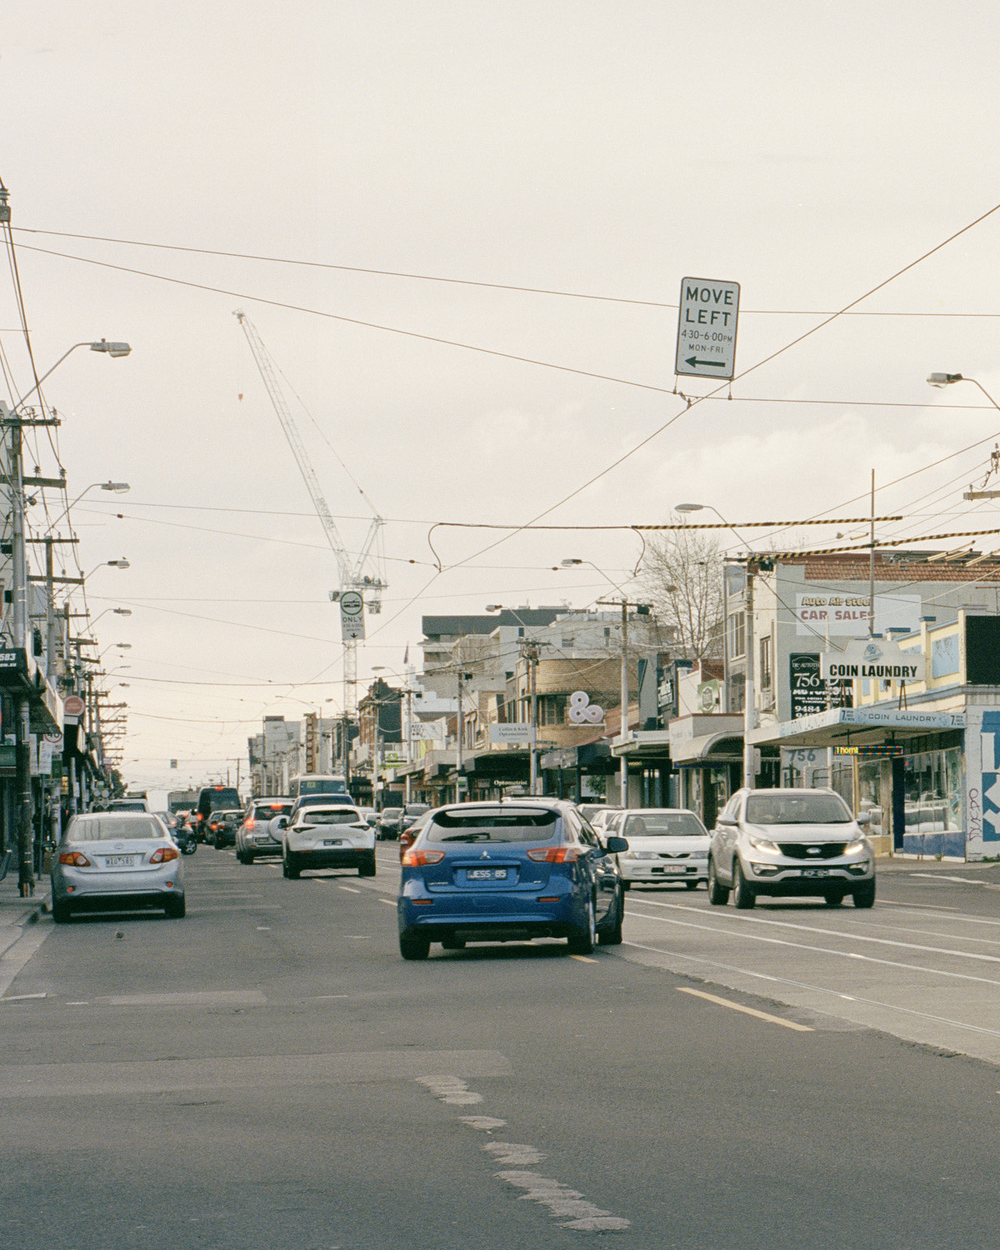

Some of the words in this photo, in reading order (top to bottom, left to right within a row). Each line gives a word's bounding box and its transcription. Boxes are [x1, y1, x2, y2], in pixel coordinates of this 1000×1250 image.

[686, 286, 734, 305] MOVE
[685, 308, 731, 326] LEFT
[800, 610, 828, 620] CAR
[829, 664, 858, 677] COIN
[861, 665, 918, 678] LAUNDRY
[794, 672, 820, 687] 756
[895, 714, 937, 722] LAUNDRY
[788, 751, 816, 762] 756
